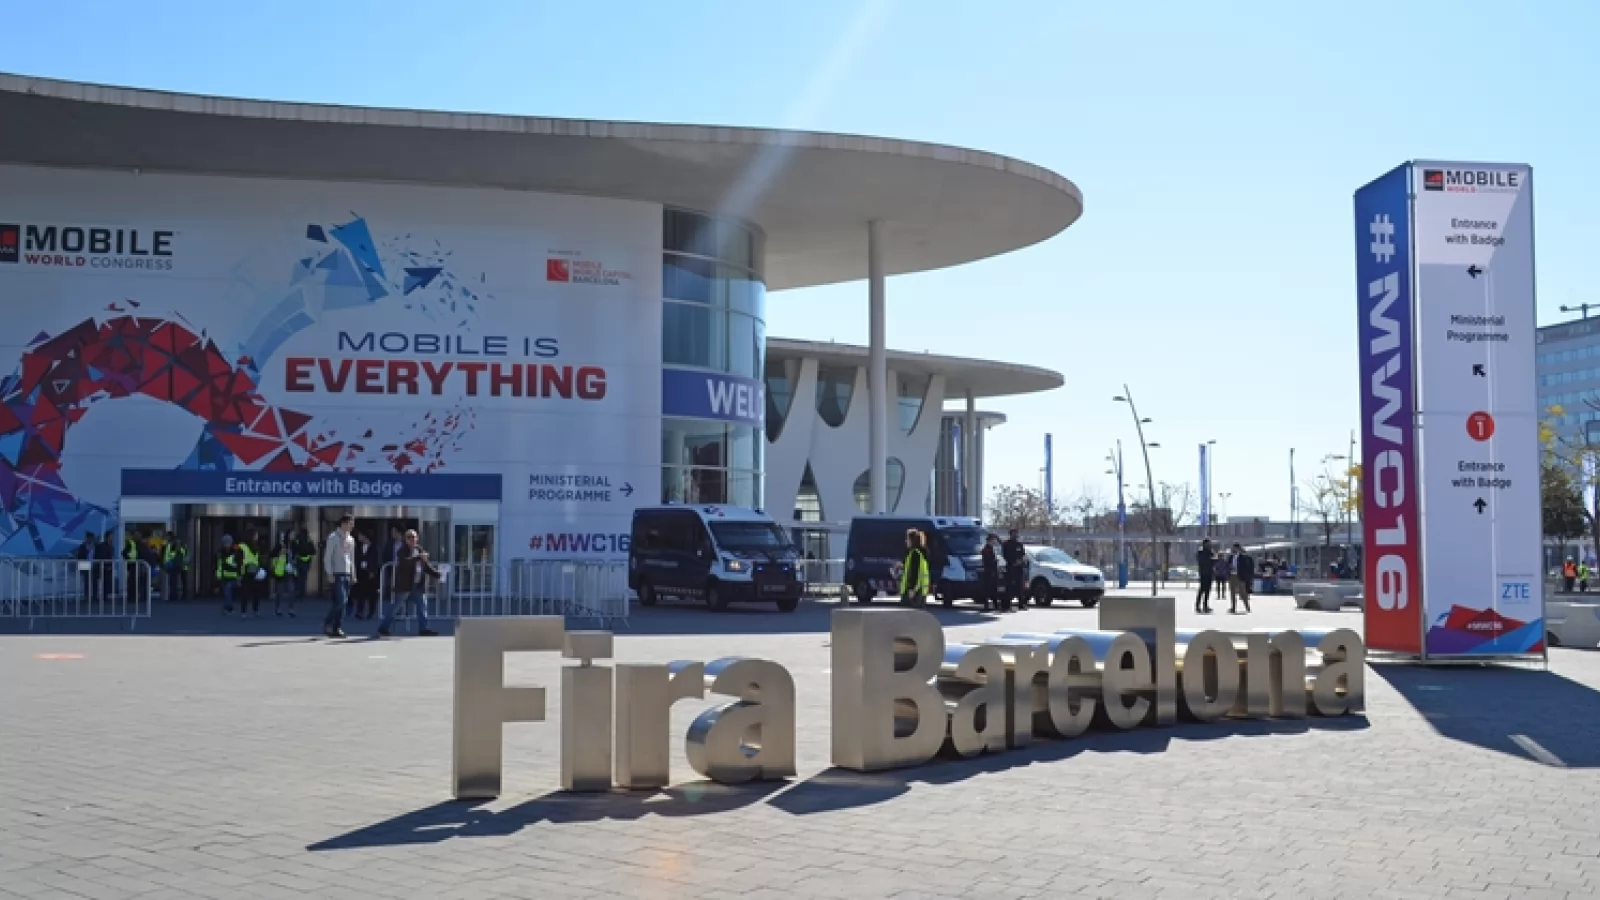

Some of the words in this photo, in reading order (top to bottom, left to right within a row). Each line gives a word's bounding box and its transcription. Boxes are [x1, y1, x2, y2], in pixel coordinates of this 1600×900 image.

[1447, 170, 1519, 187] MOBILE
[1451, 218, 1497, 230] Entrance
[26, 224, 174, 256] MOBILE
[1445, 235, 1469, 245] with
[1471, 235, 1505, 246] Badge
[25, 254, 87, 267] WORLD
[90, 257, 173, 271] CONGRESS
[1451, 315, 1505, 326] Ministerial
[338, 332, 507, 356] MOBILE
[525, 338, 559, 357] IS
[1447, 331, 1508, 343] Programme
[285, 358, 606, 400] EVERYTHING
[1368, 213, 1408, 610] #MWC16
[1477, 421, 1484, 437] 1
[1458, 461, 1505, 473] Entrance
[225, 478, 301, 494] Entrance
[307, 479, 344, 494] with
[349, 480, 403, 498] Badge
[529, 473, 611, 488] MINISTERIAL
[1452, 478, 1475, 488] with
[1477, 478, 1511, 490] Badge
[529, 488, 611, 502] PROGRAMME
[528, 533, 631, 553] #MWC16
[1502, 582, 1530, 599] ZTE
[453, 614, 796, 798] Fira
[831, 597, 1365, 772] Barcelona
